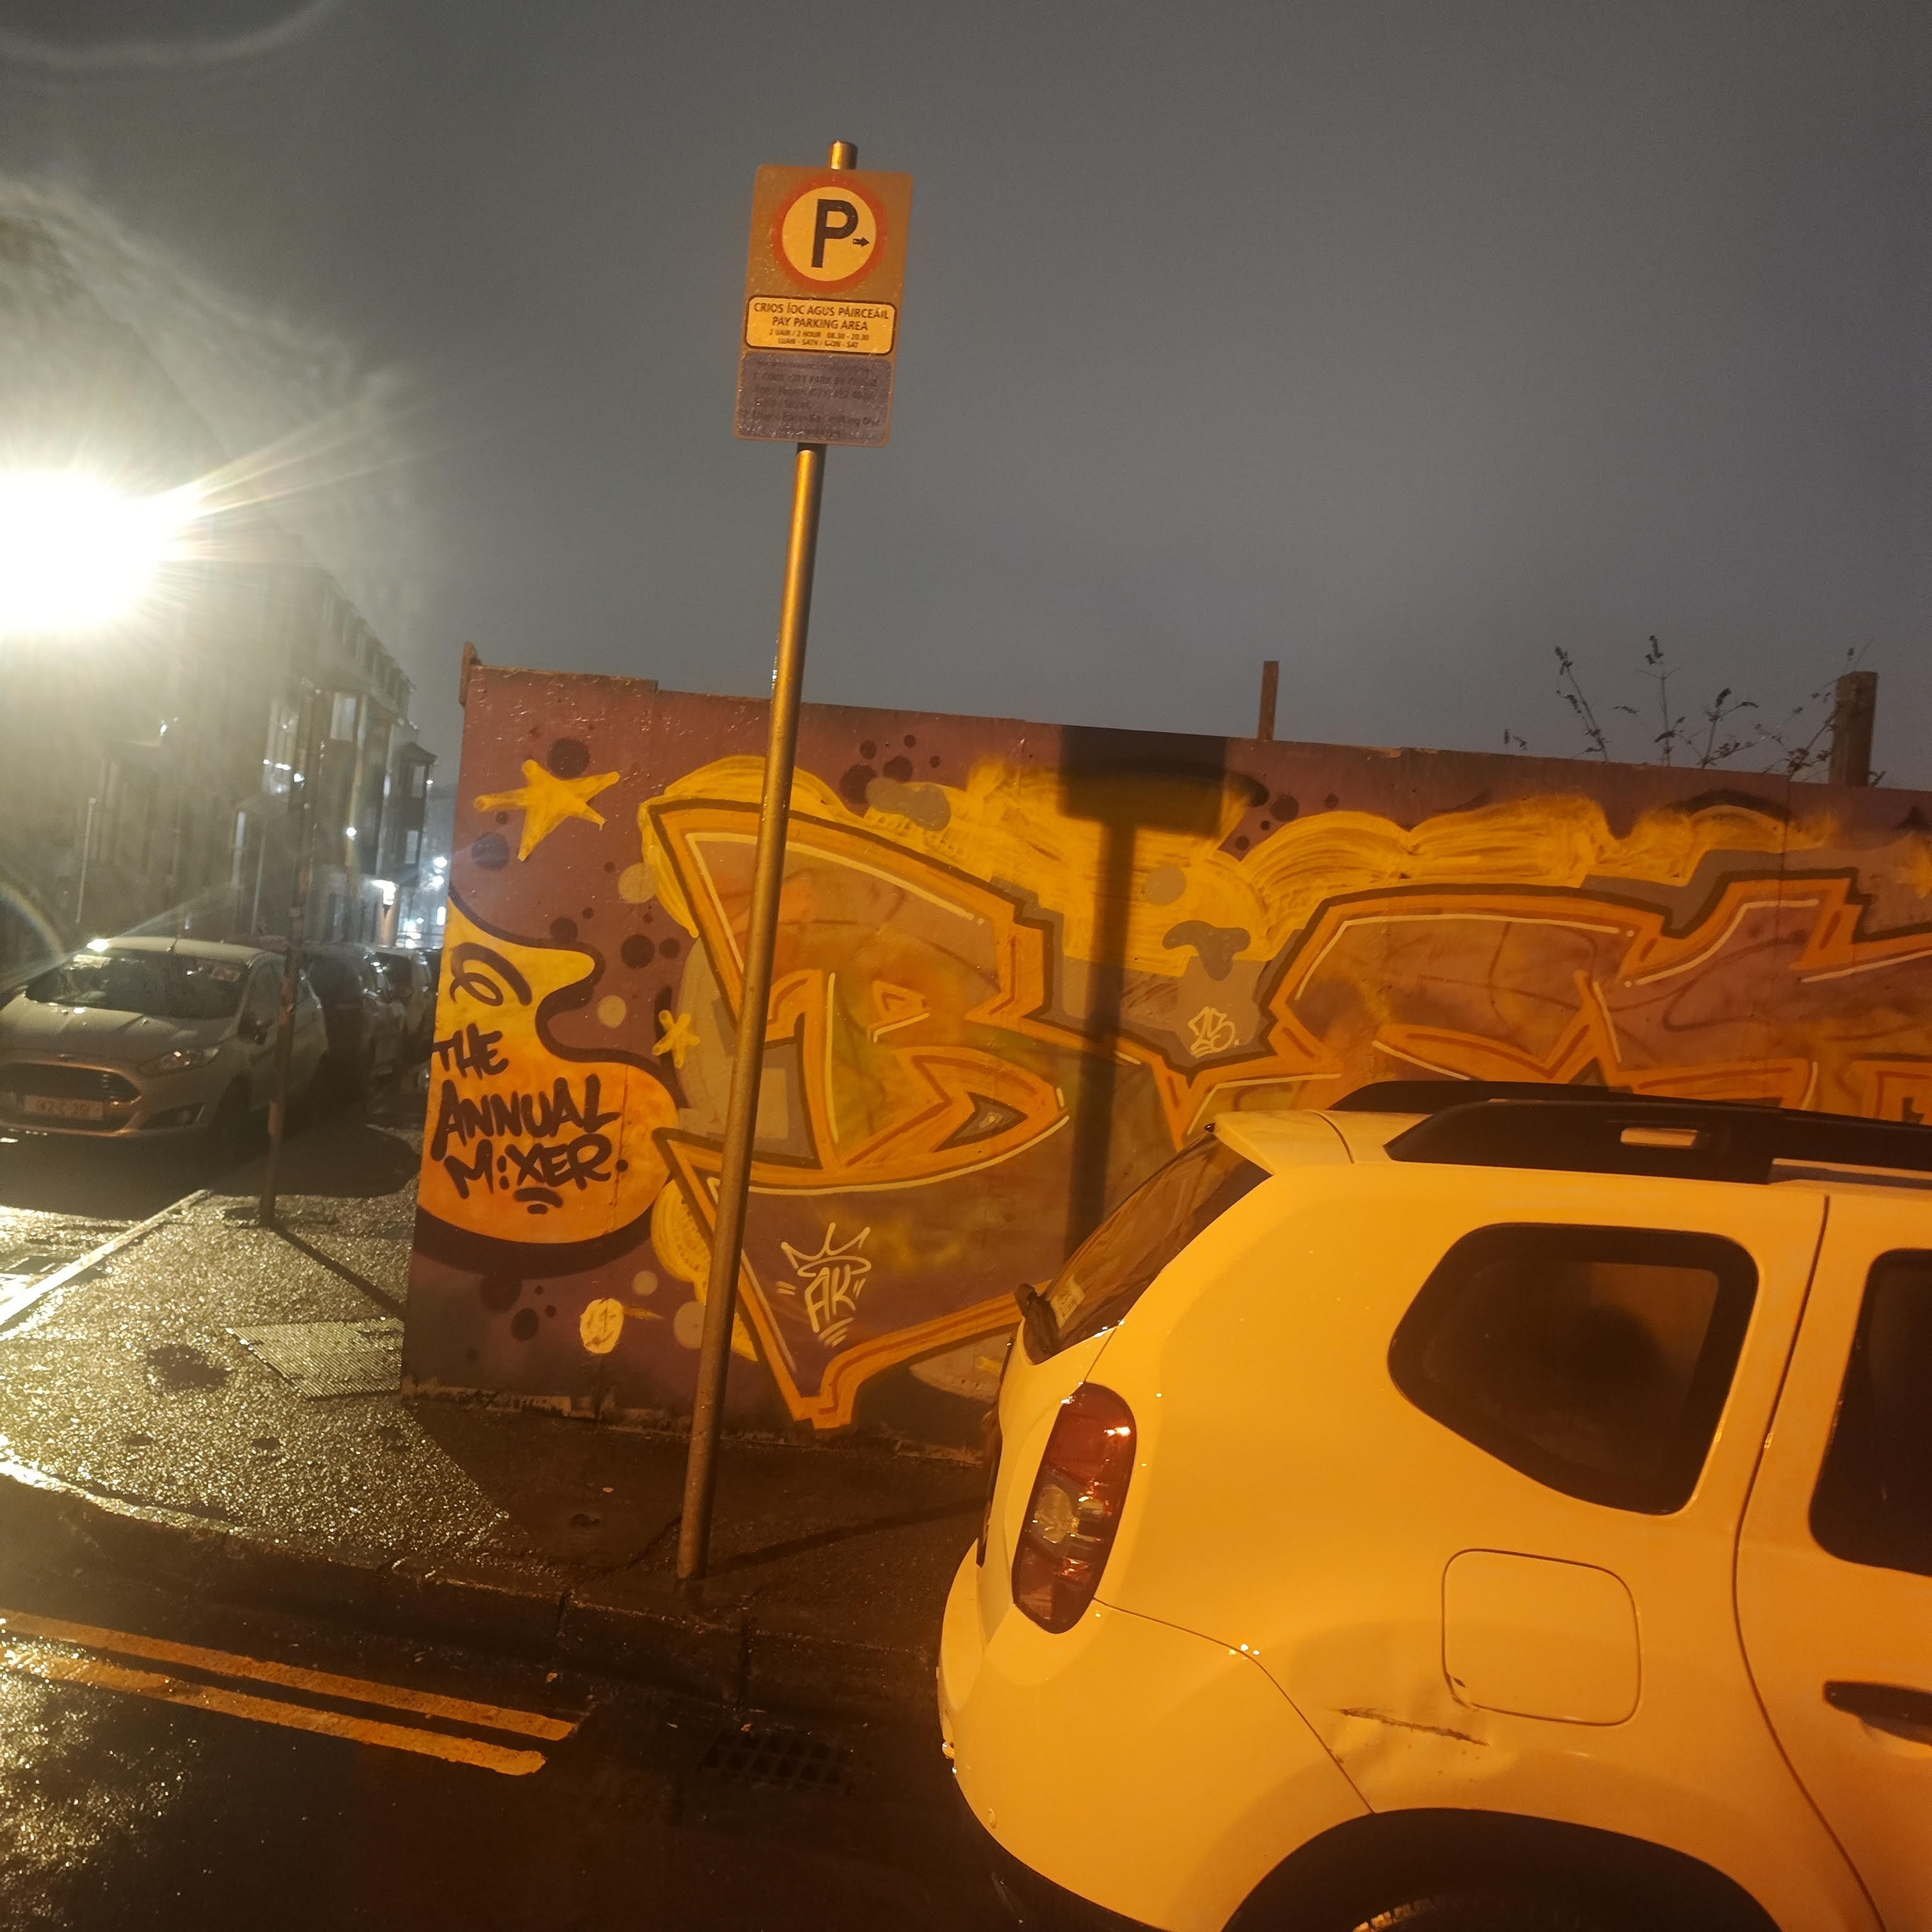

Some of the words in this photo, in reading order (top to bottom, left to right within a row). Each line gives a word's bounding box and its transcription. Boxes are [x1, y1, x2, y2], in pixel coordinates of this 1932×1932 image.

[811, 199, 858, 268] P
[754, 303, 784, 313] CRIOS
[806, 306, 835, 316] AGUS
[838, 306, 889, 319] PÁIRCEÁIL
[772, 316, 791, 326] PAY
[794, 318, 838, 330] PARKING
[840, 319, 868, 331] AREA
[432, 1023, 509, 1079] THE
[431, 1073, 621, 1161] ANNUAL
